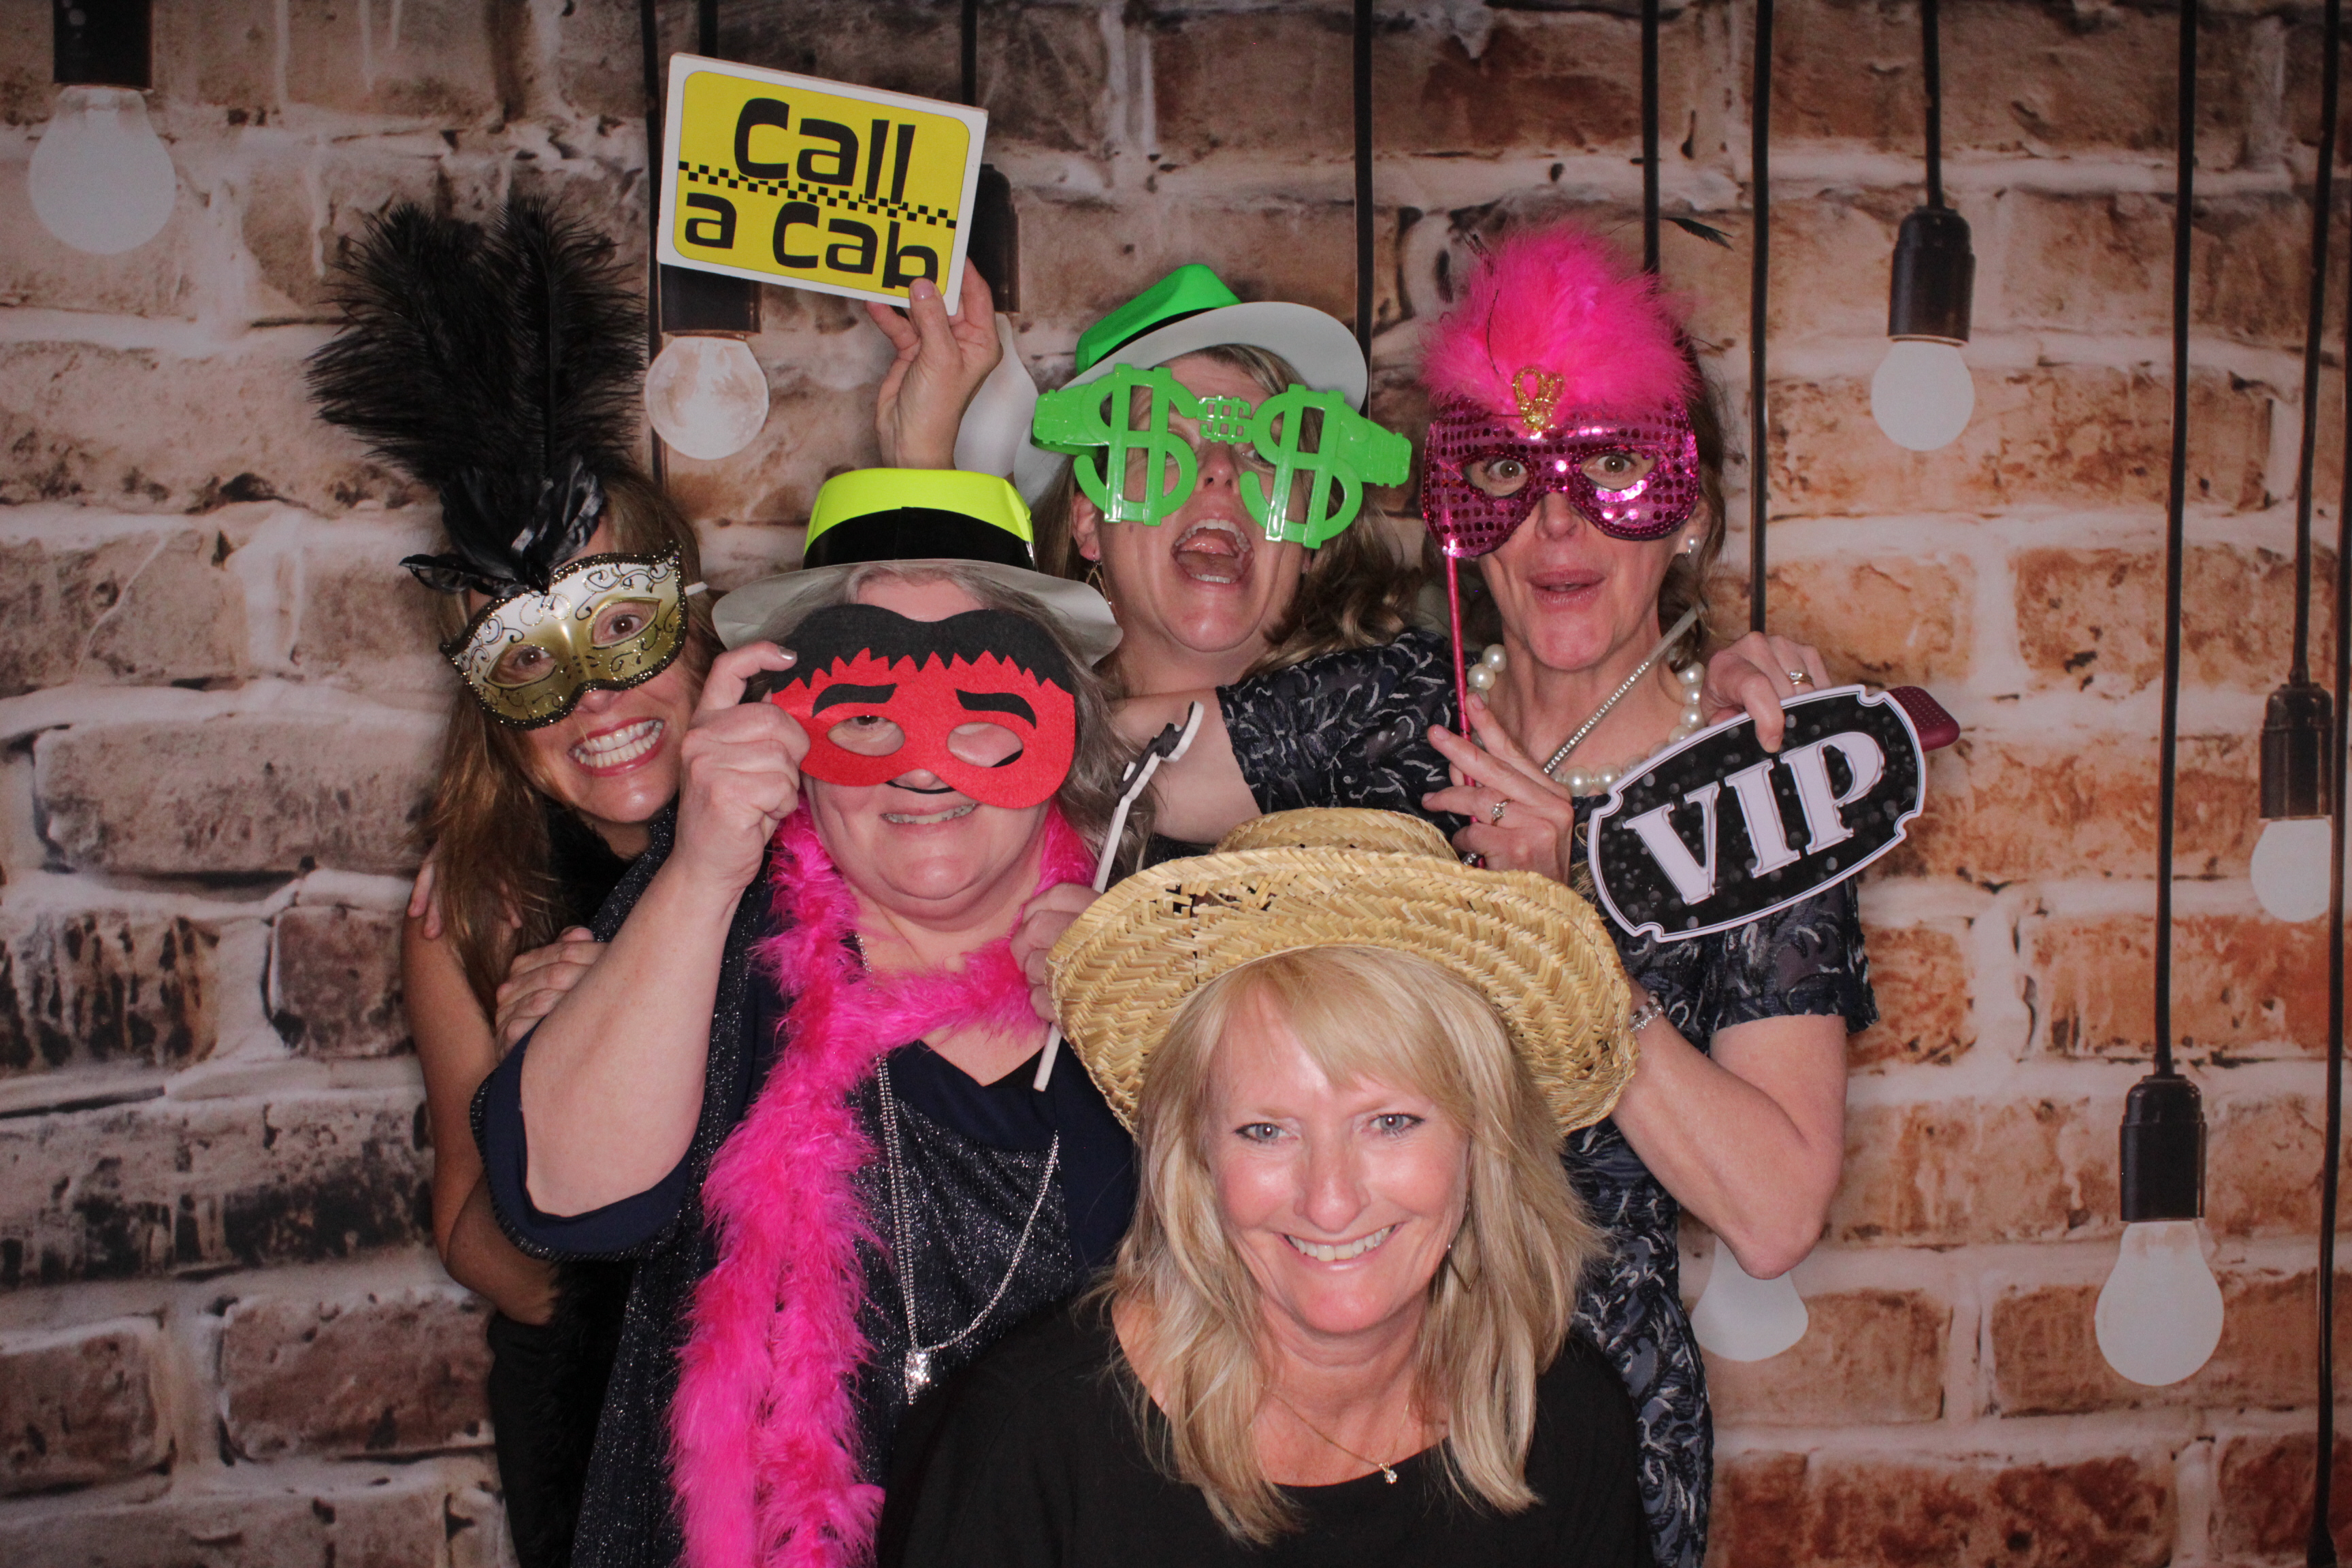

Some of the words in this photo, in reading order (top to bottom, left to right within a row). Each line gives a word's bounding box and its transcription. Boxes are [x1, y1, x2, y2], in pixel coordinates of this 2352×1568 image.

[734, 97, 916, 205] Call
[684, 192, 737, 250] a
[772, 201, 938, 289] Cab
[1622, 731, 1885, 905] VIP
